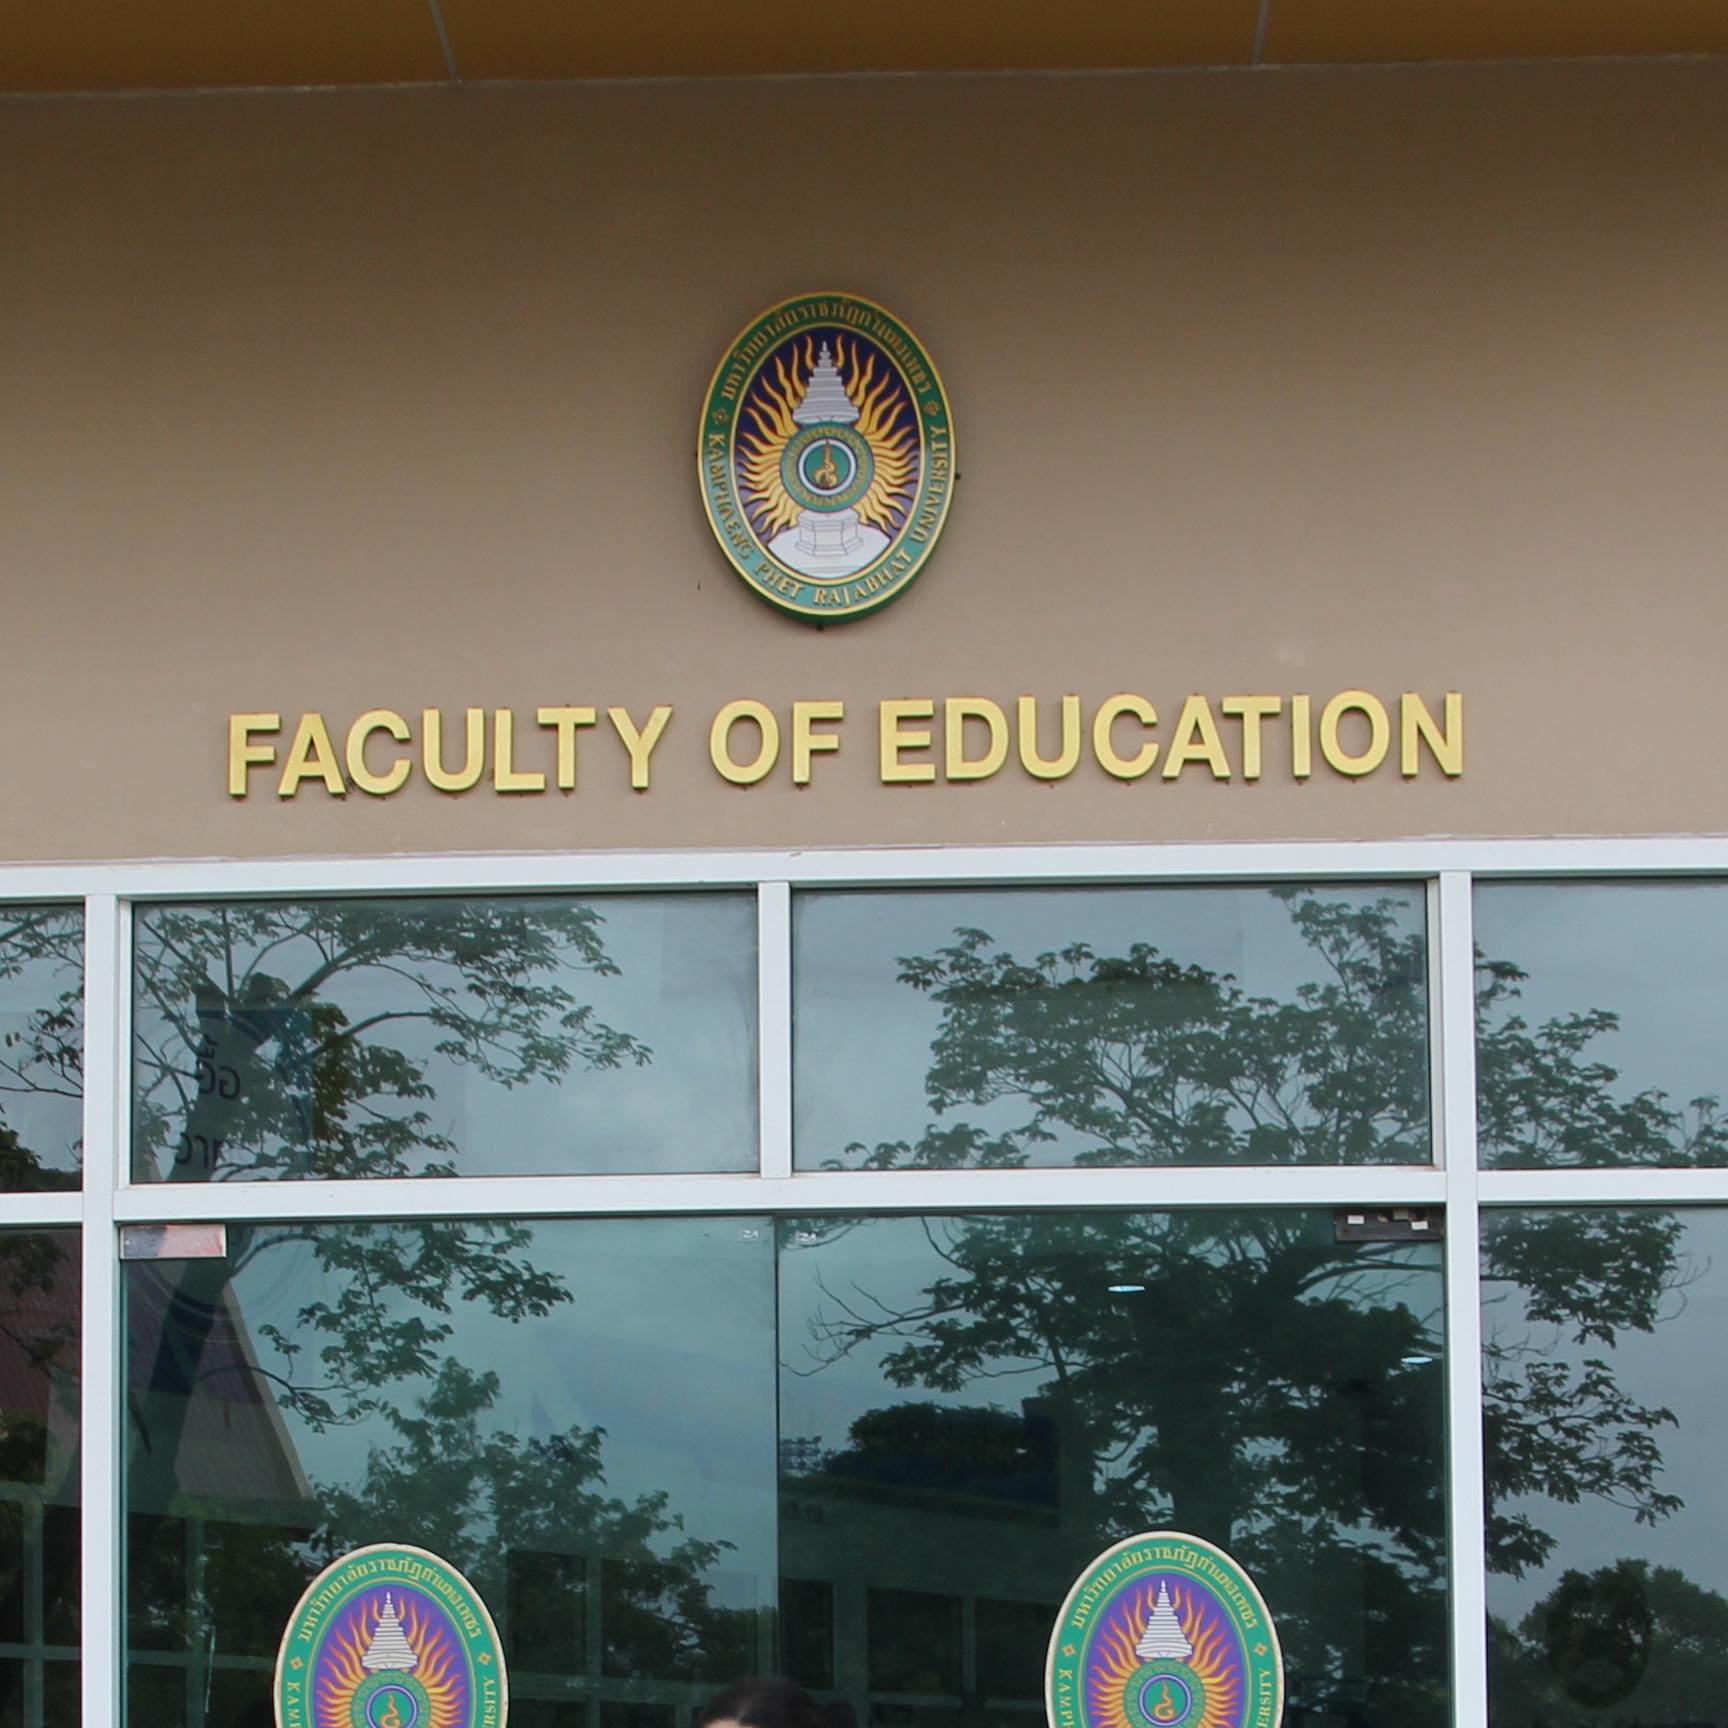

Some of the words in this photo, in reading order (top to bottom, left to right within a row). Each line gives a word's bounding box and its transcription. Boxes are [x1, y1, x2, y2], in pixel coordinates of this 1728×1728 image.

[709, 432, 756, 561] KAMPHAENG
[754, 562, 806, 600] PHET
[812, 550, 913, 608] RAJABHAT
[910, 424, 948, 545] UNIVERSITY
[227, 704, 673, 798] FACULTY
[708, 698, 845, 790] OF
[878, 691, 1465, 786] EDUCATION
